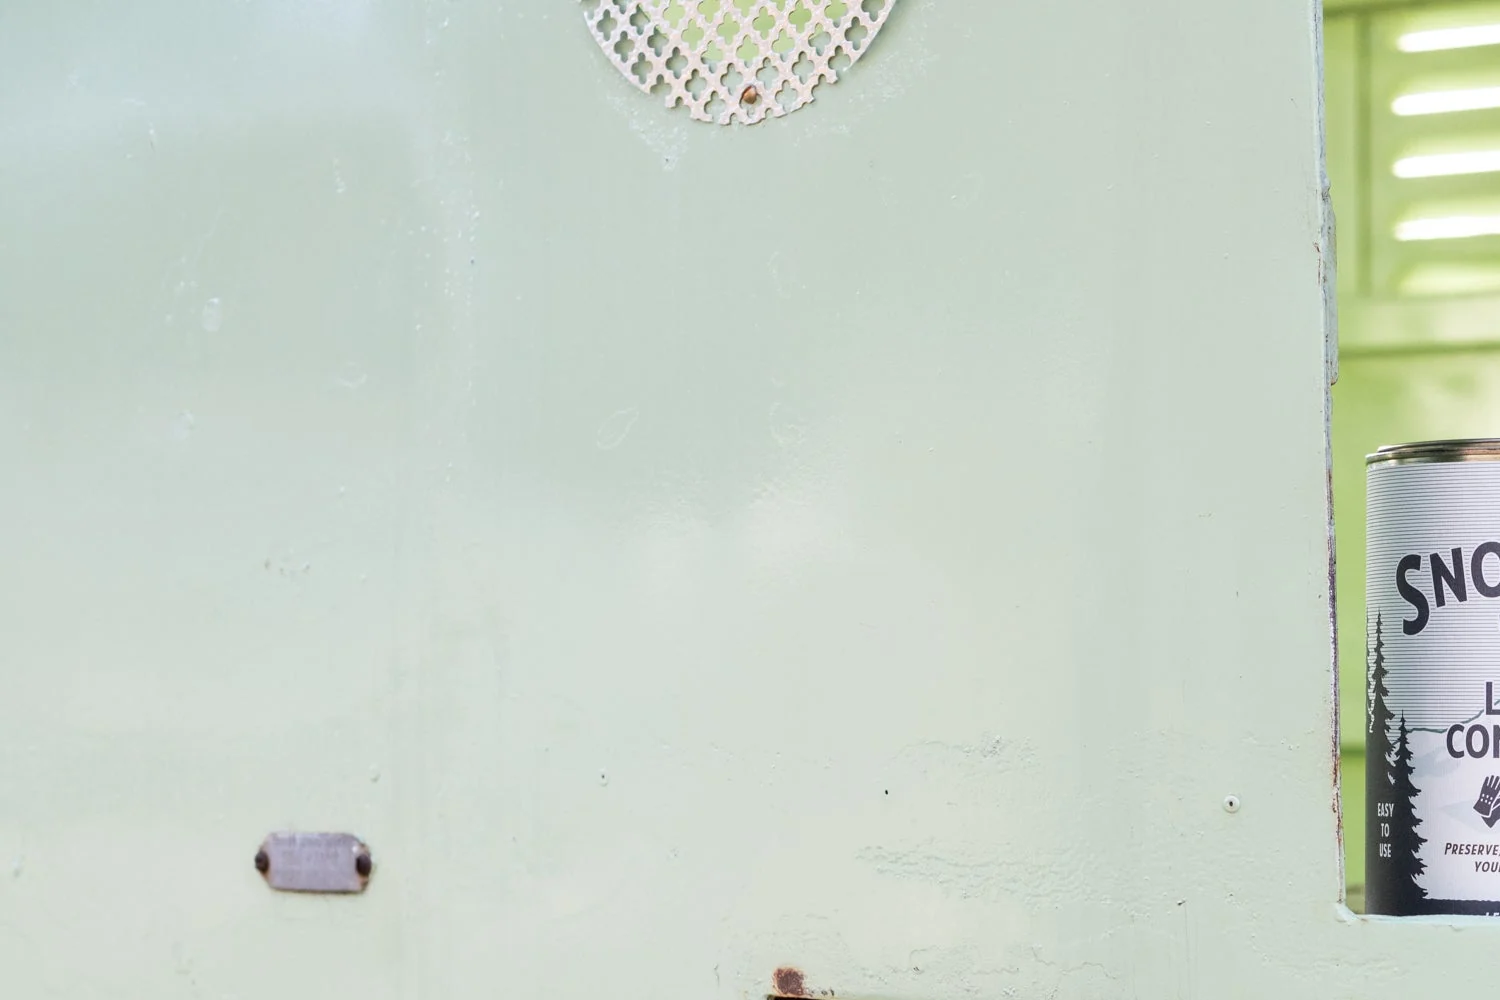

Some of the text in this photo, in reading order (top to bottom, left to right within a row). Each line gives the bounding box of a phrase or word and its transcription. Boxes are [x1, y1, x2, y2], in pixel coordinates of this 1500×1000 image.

[1377, 802, 1395, 818] EASY
[1380, 823, 1390, 838] TO
[1379, 843, 1392, 858] USE
